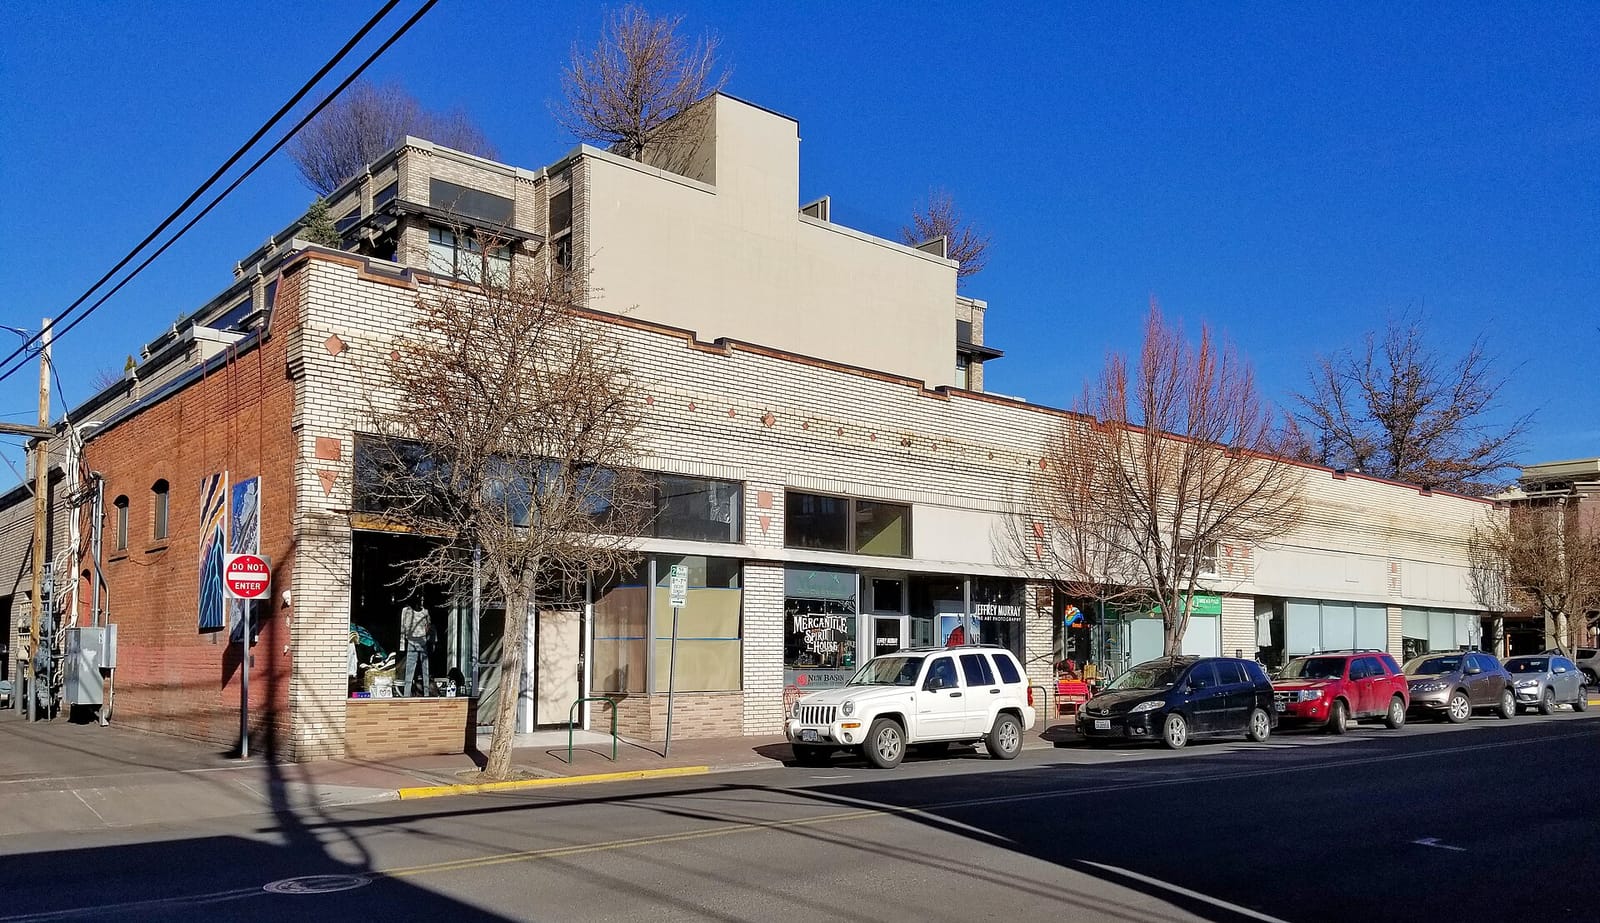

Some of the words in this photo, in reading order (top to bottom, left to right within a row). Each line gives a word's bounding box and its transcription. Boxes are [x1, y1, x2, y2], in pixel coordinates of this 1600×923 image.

[247, 563, 264, 571] NOT
[235, 582, 260, 590] ENTER
[975, 604, 997, 615] JEFFREY
[998, 605, 1021, 617] MURRAY
[792, 613, 848, 634] MERCANTILE
